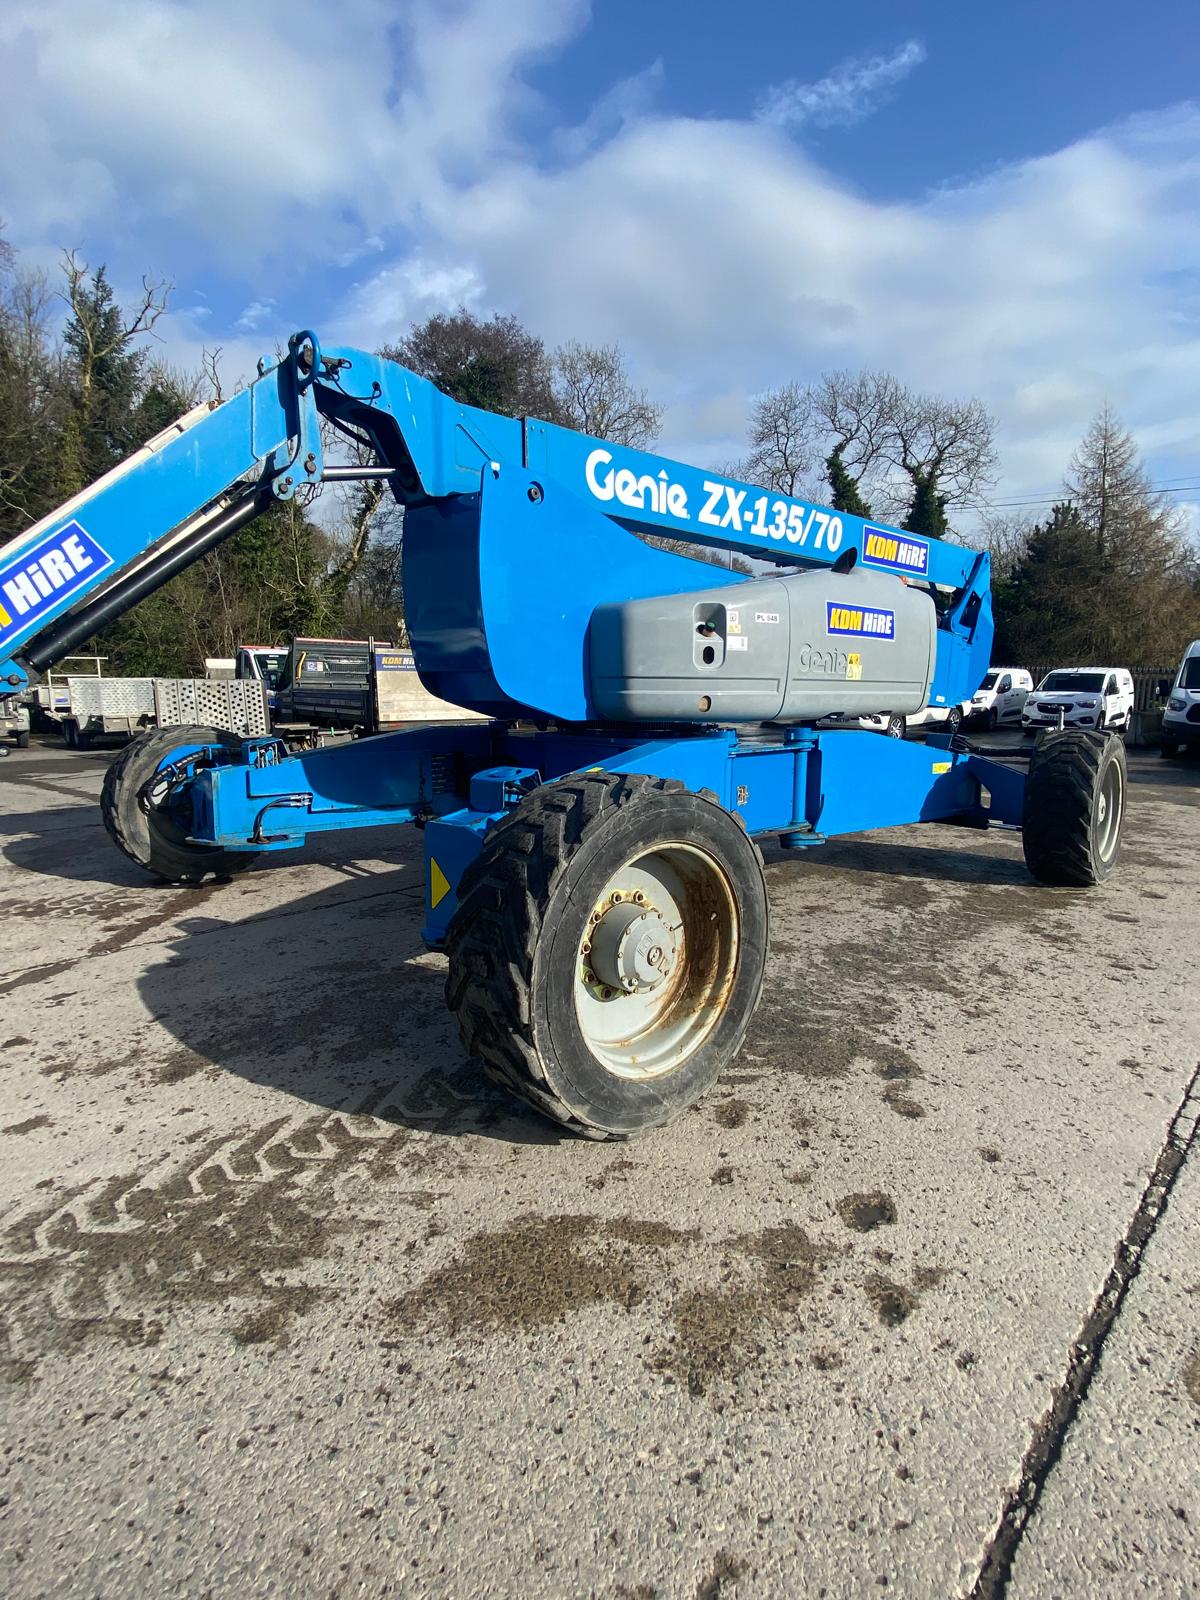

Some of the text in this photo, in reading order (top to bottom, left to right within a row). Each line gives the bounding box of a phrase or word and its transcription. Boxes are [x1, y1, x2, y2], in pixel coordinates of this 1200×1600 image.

[585, 448, 844, 553] Genie ZX-135/70
[865, 533, 899, 562] KDM
[829, 607, 863, 631] KDM
[800, 642, 848, 674] Genie
